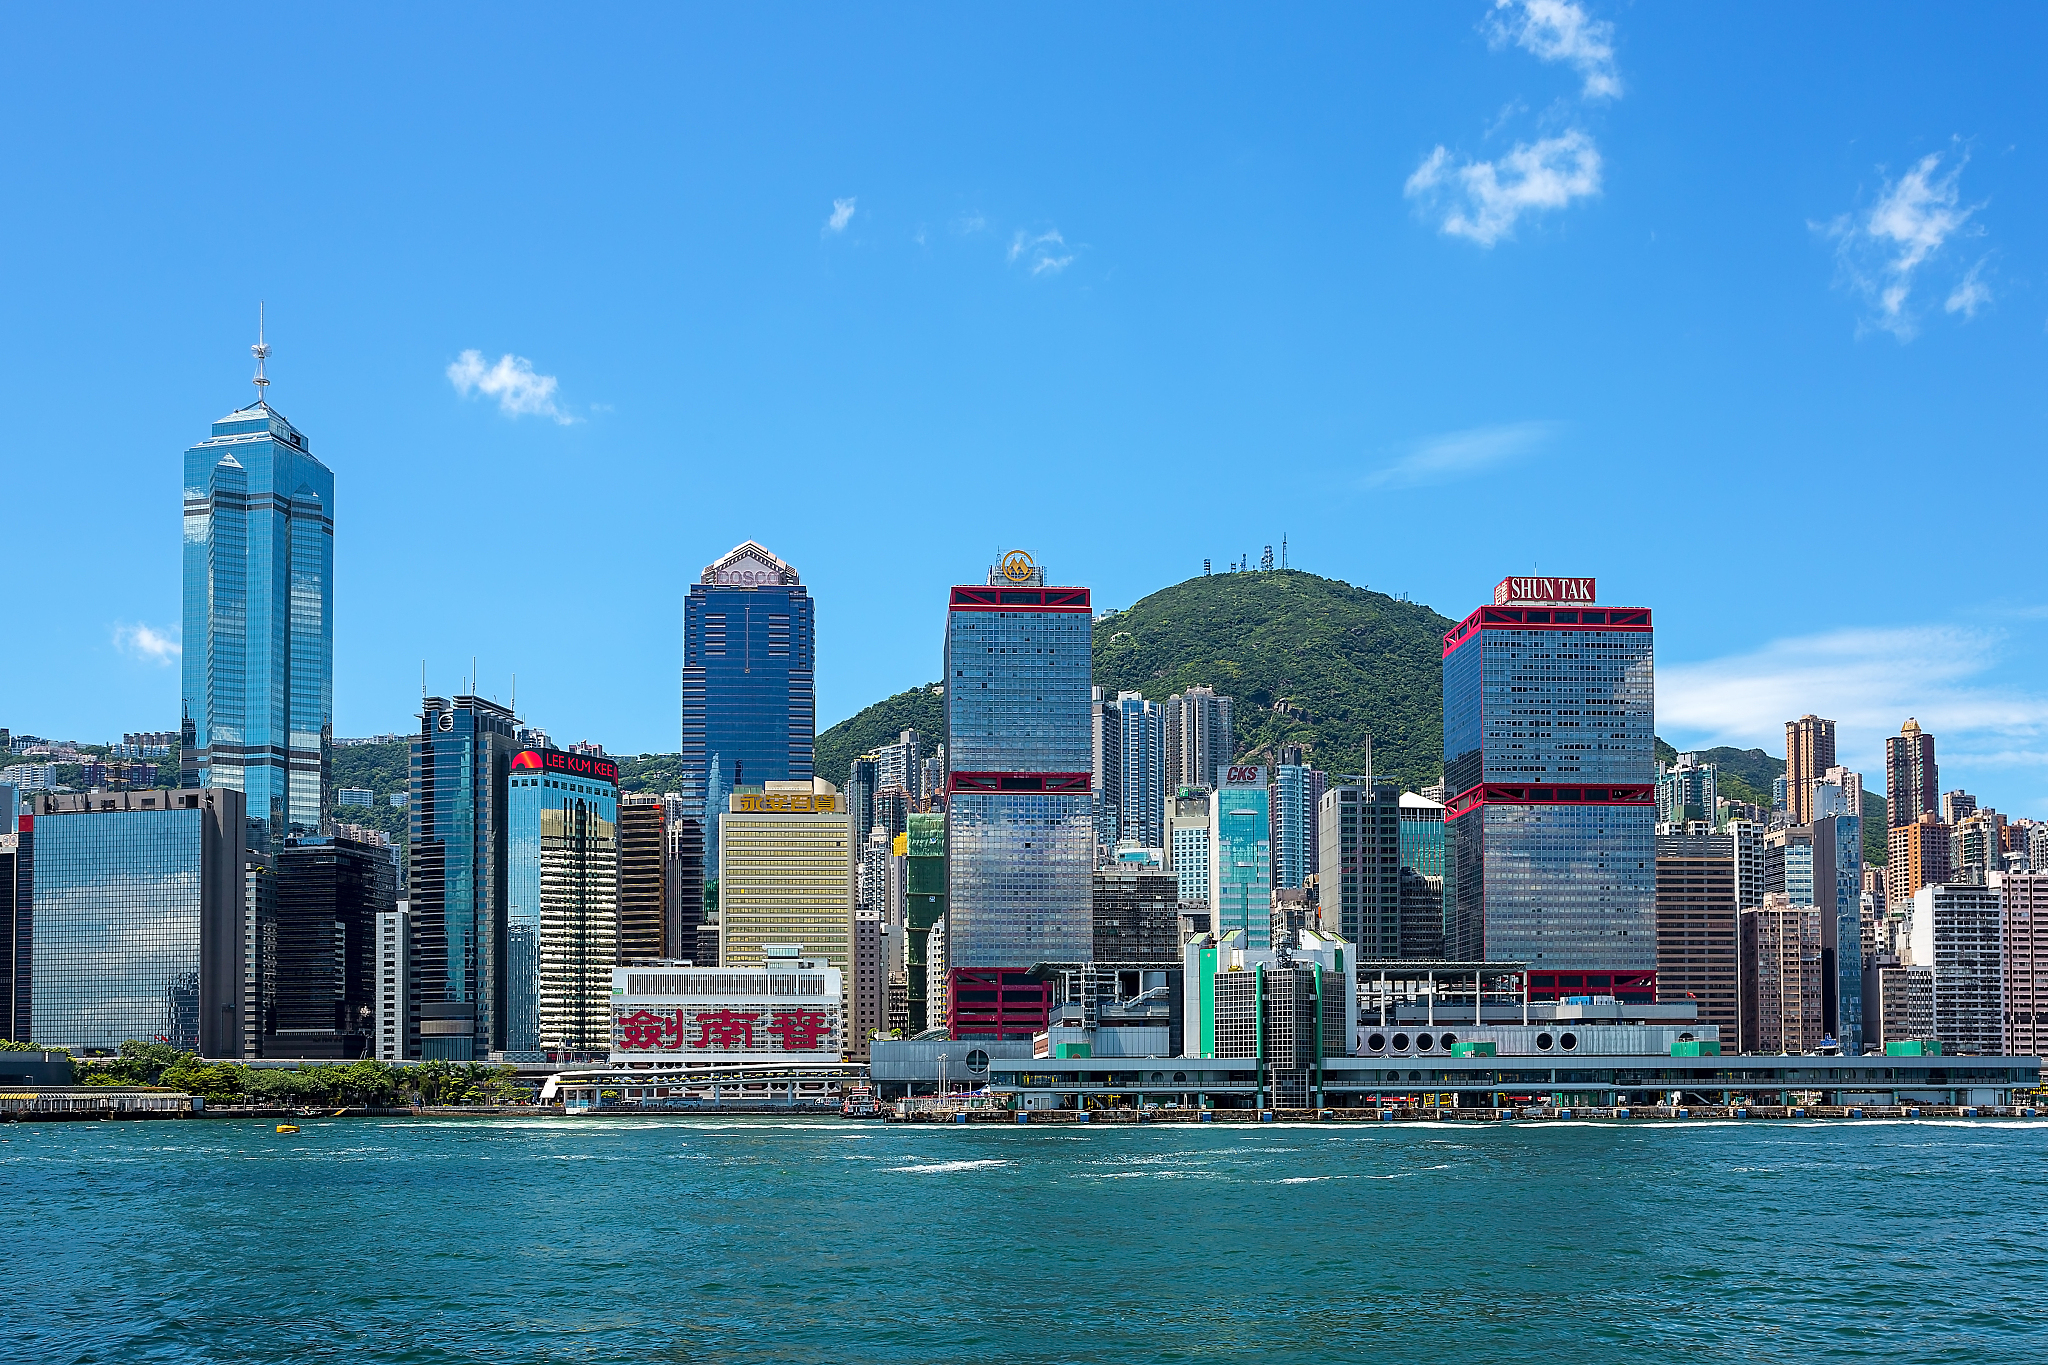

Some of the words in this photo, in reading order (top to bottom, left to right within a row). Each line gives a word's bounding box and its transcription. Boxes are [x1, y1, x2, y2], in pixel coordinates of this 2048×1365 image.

[718, 571, 779, 585] COSCO
[1511, 578, 1554, 599] SHUN
[1558, 579, 1591, 600] TAK
[546, 753, 565, 769] LEE
[567, 757, 591, 774] KUM
[594, 761, 613, 777] KEE
[1226, 766, 1259, 781] CKS
[740, 794, 835, 812] 永安百貨
